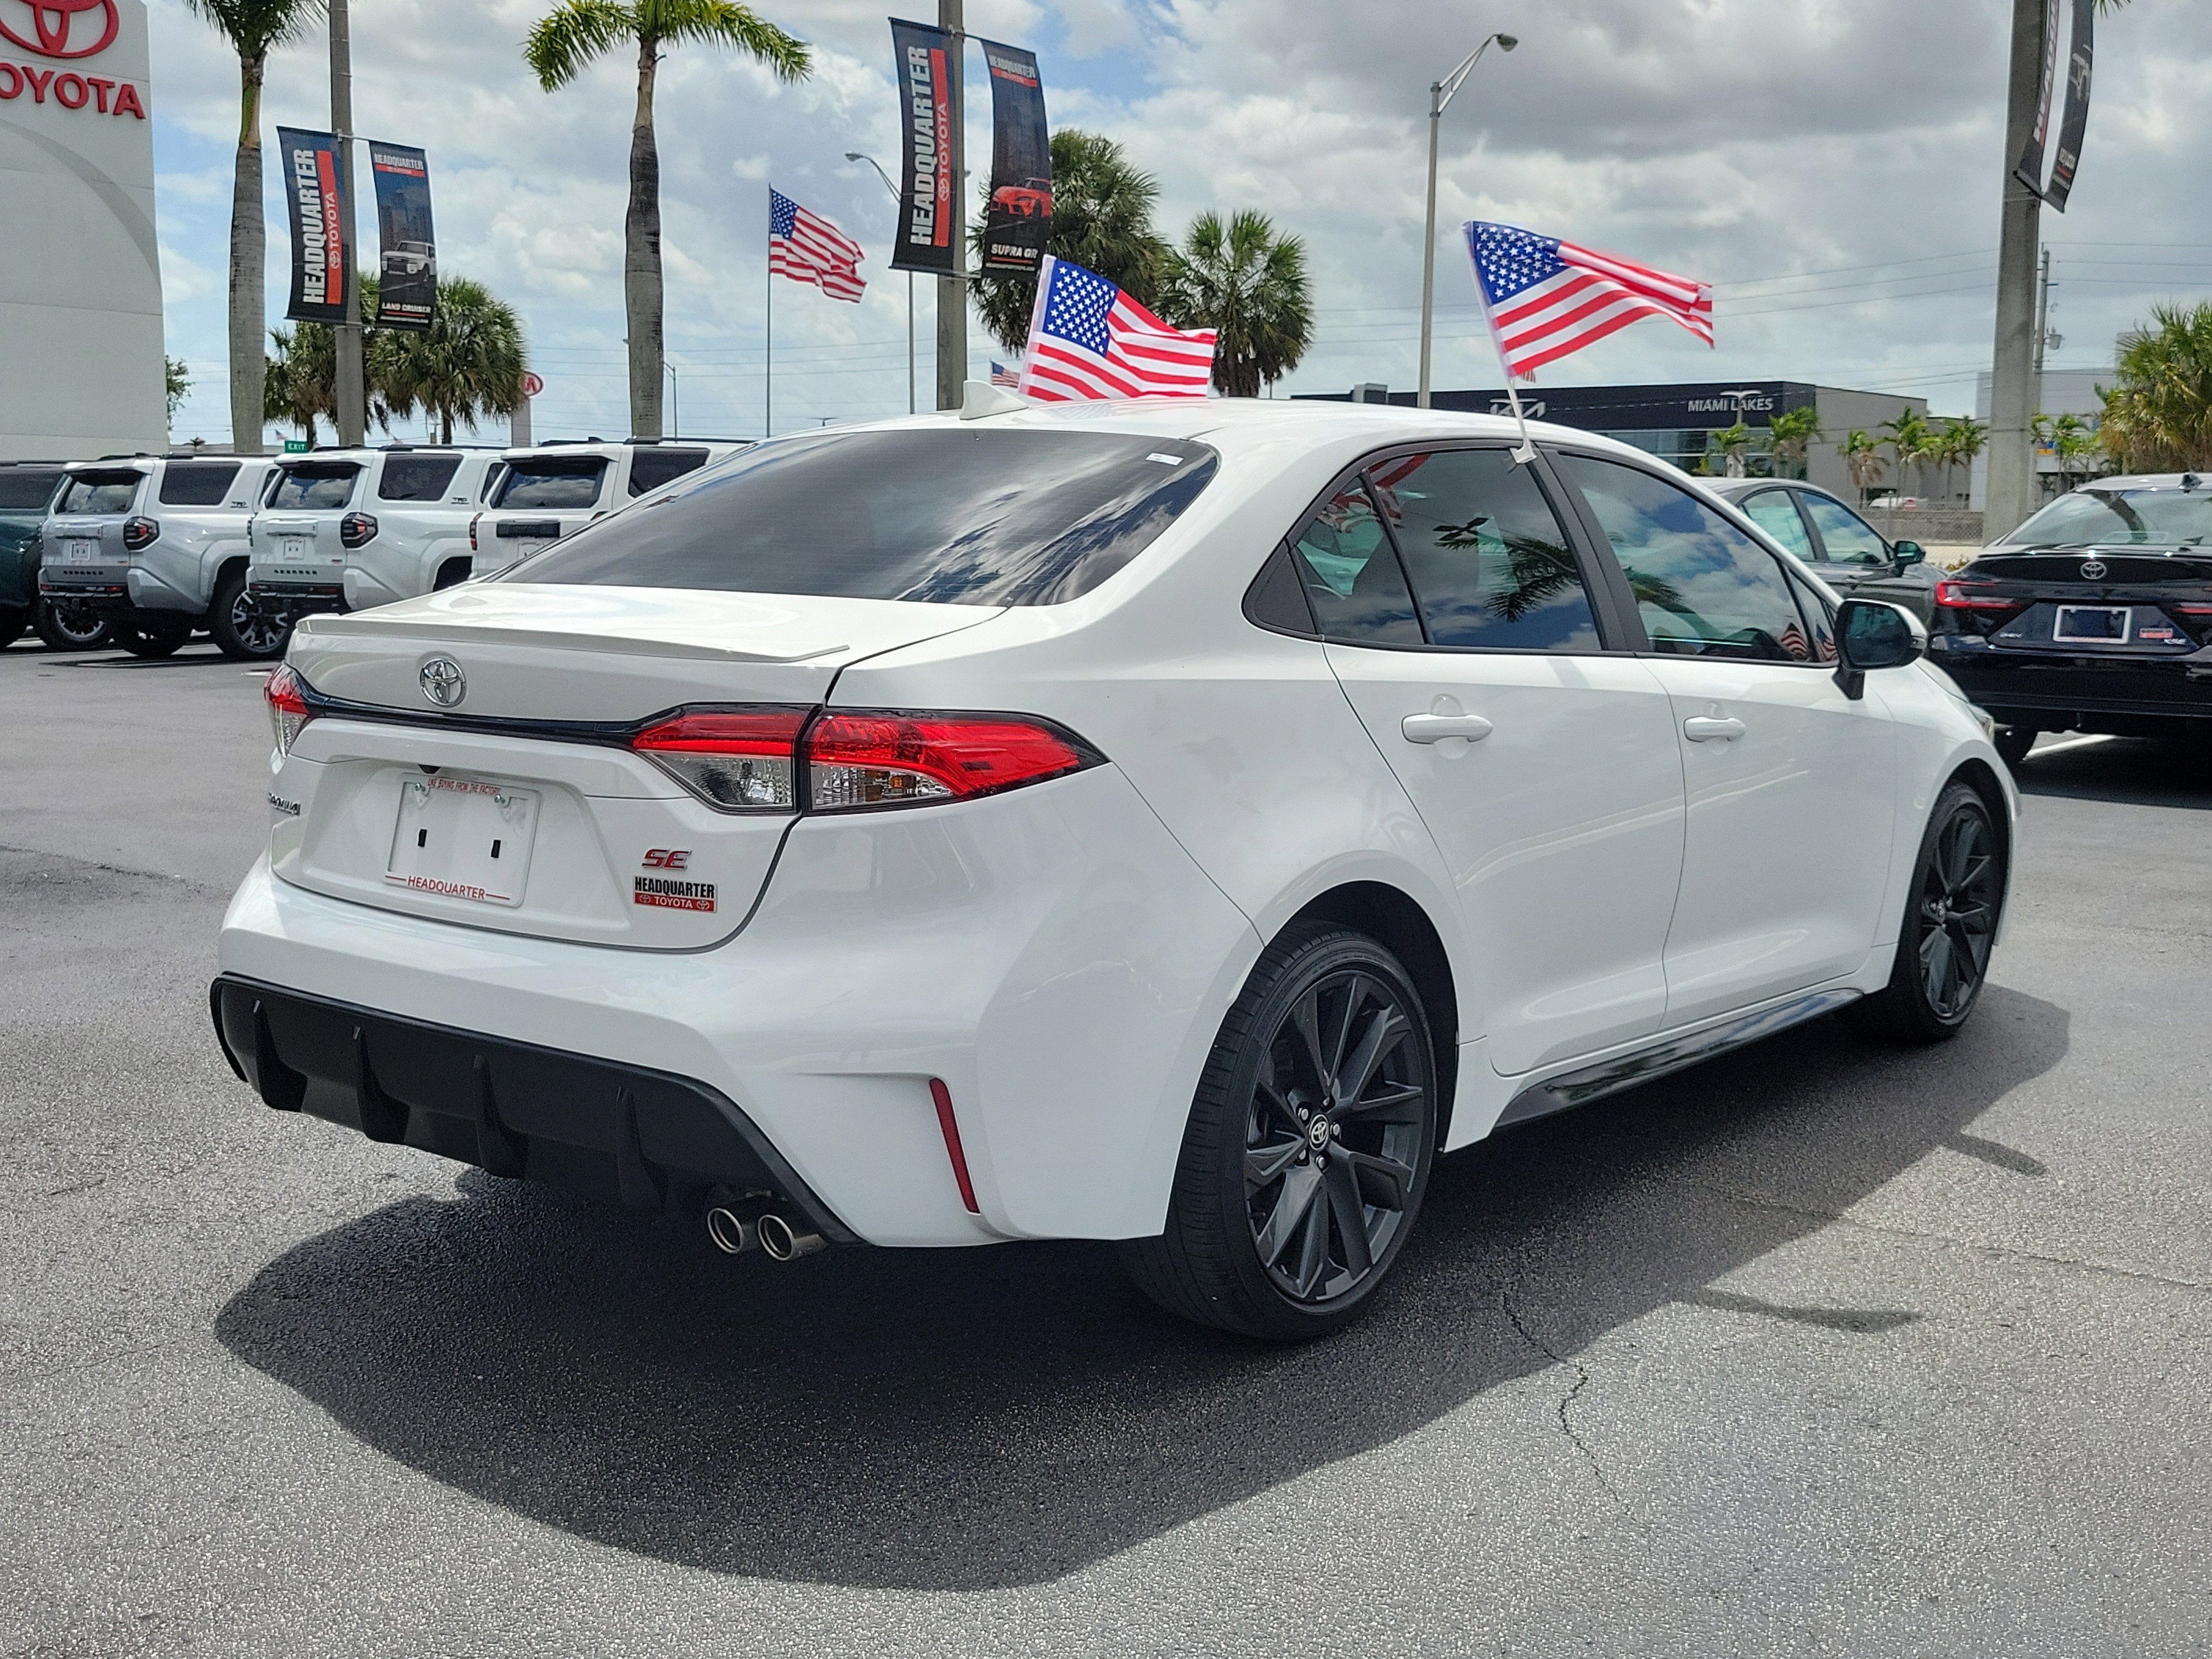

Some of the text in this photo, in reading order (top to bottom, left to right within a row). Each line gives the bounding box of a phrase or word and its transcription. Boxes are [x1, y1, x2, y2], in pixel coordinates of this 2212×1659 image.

[908, 47, 938, 245] HEADQUARTER
[937, 102, 949, 177] TOYOTA
[294, 149, 326, 303] HEADQUARTER
[325, 192, 339, 249] TOYOTA
[991, 244, 1038, 258] SUPRA GR
[381, 302, 401, 311] LAND
[1688, 398, 1773, 412] MIAMI LAKES
[641, 848, 692, 870] SE
[408, 875, 486, 899] HEADQUARTER
[635, 876, 715, 898] HEADQUARTER
[654, 896, 693, 909] TOYOTA
